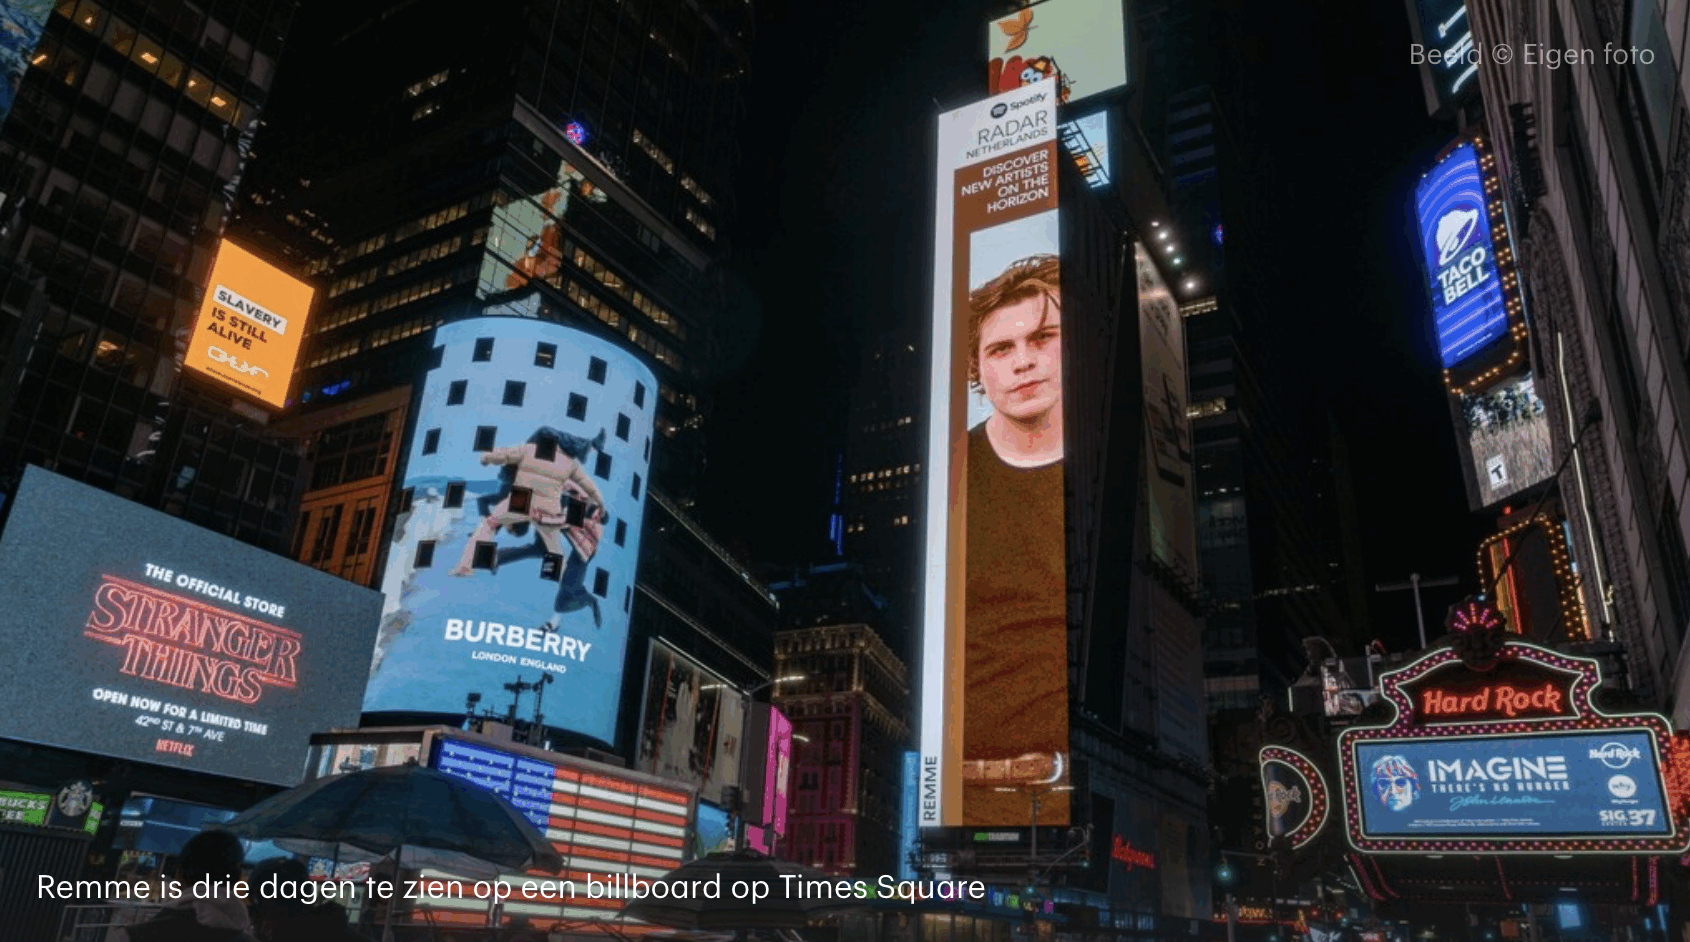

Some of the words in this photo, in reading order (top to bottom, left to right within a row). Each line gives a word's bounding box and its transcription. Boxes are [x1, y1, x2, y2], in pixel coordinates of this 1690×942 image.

[1010, 92, 1047, 111] Spotify
[966, 127, 1048, 160] NETHERLANDS
[978, 110, 1048, 145] RADAR
[961, 179, 993, 196] NEW
[995, 161, 1049, 187] ARTISTS
[982, 149, 1049, 178] DISCOVER
[986, 186, 1049, 214] HORIZON
[997, 183, 1019, 198] ON
[1022, 173, 1049, 190] THE
[1437, 247, 1486, 288] TACO
[1444, 266, 1491, 305] BELL
[211, 307, 226, 322] IS
[229, 316, 268, 344] STILL
[217, 290, 282, 329] SLAVERY
[207, 322, 253, 350] ALIVE
[145, 563, 175, 583] THE
[176, 574, 241, 605] OFFICIAL
[243, 595, 286, 619] STORE
[86, 582, 302, 682] STRANGER
[444, 618, 592, 662] BURBERRY
[119, 634, 263, 704] THINGS
[471, 650, 517, 664] LONDON
[519, 657, 567, 674] ENGLAND
[92, 687, 129, 706] OPEN
[129, 695, 162, 712] NOW
[163, 702, 187, 718] FOR
[188, 709, 198, 721] A
[200, 711, 242, 731] LIMITED
[244, 720, 269, 736] TIME
[1423, 686, 1490, 714] Hard
[1494, 684, 1562, 717] Rock
[155, 738, 195, 757] NETFLIX
[161, 719, 175, 732] ST
[175, 724, 185, 735] &
[203, 729, 226, 742] AVE
[1428, 756, 1568, 782] IMAGINE
[923, 756, 937, 822] REMME
[1628, 809, 1656, 826] 37
